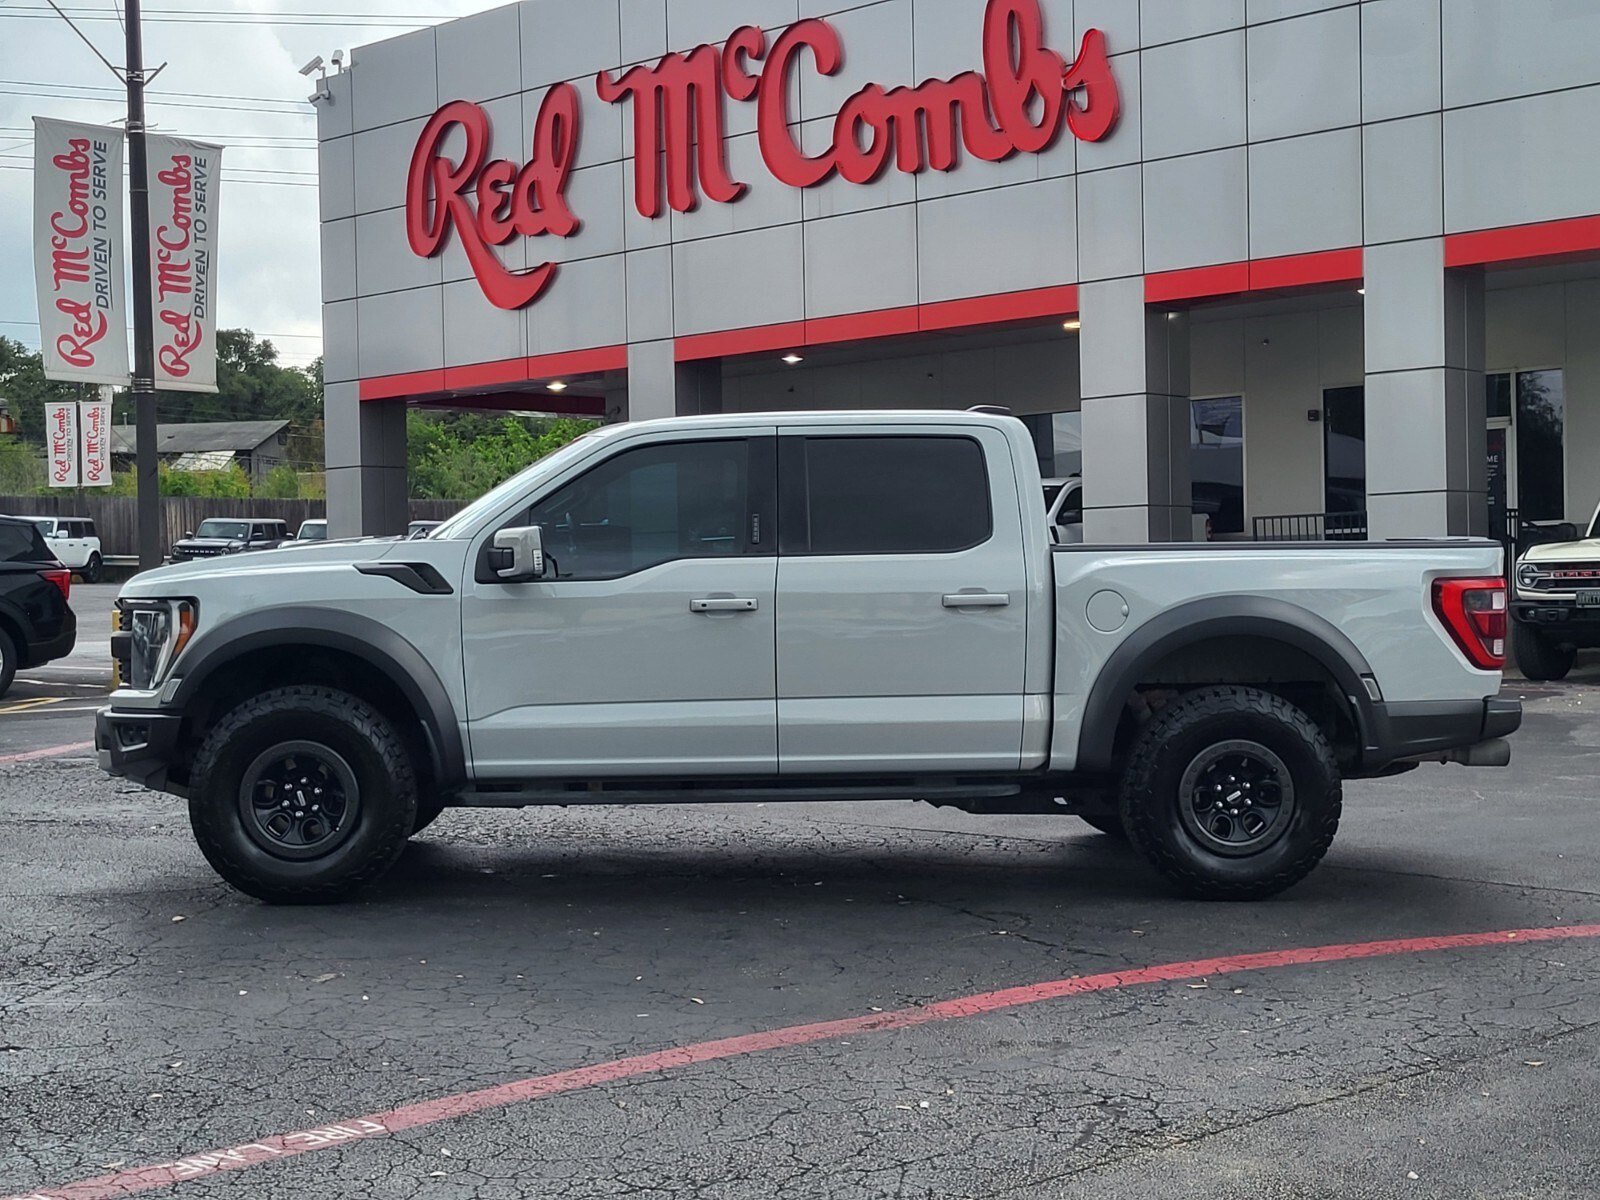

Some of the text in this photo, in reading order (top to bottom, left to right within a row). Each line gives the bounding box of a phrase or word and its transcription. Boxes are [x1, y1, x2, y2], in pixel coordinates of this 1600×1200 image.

[93, 140, 109, 309] DRIVEN TO SERVE
[194, 156, 207, 319] DRIVEN TO SERVE
[406, 0, 1120, 311] Red McCombs
[51, 138, 107, 367] Red McCombs
[157, 155, 202, 377] Red McCombs
[53, 407, 71, 482] Red McCombs
[87, 407, 104, 481] Red McCombs
[285, 1119, 387, 1146] FIRE
